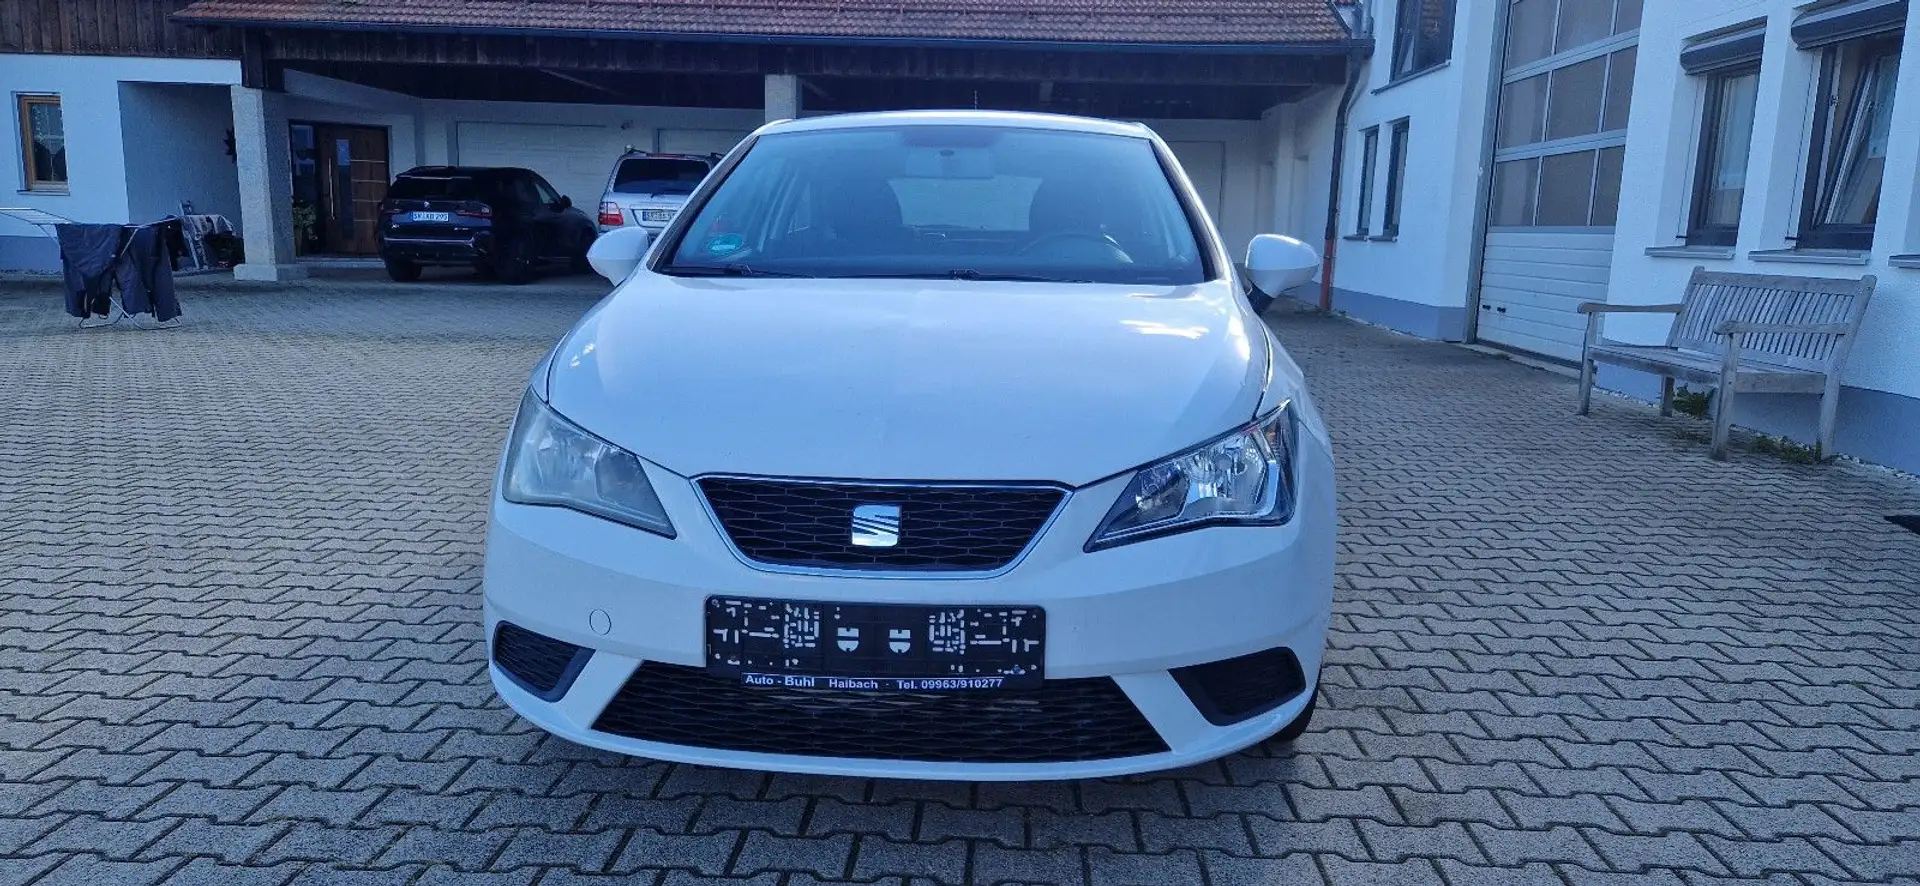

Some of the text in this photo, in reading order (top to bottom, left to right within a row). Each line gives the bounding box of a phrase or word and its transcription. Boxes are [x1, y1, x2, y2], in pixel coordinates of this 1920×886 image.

[745, 675, 774, 685] Auto
[784, 676, 815, 687] Buhl
[896, 679, 918, 689] Tel.
[921, 678, 1003, 690] 09963/910277
